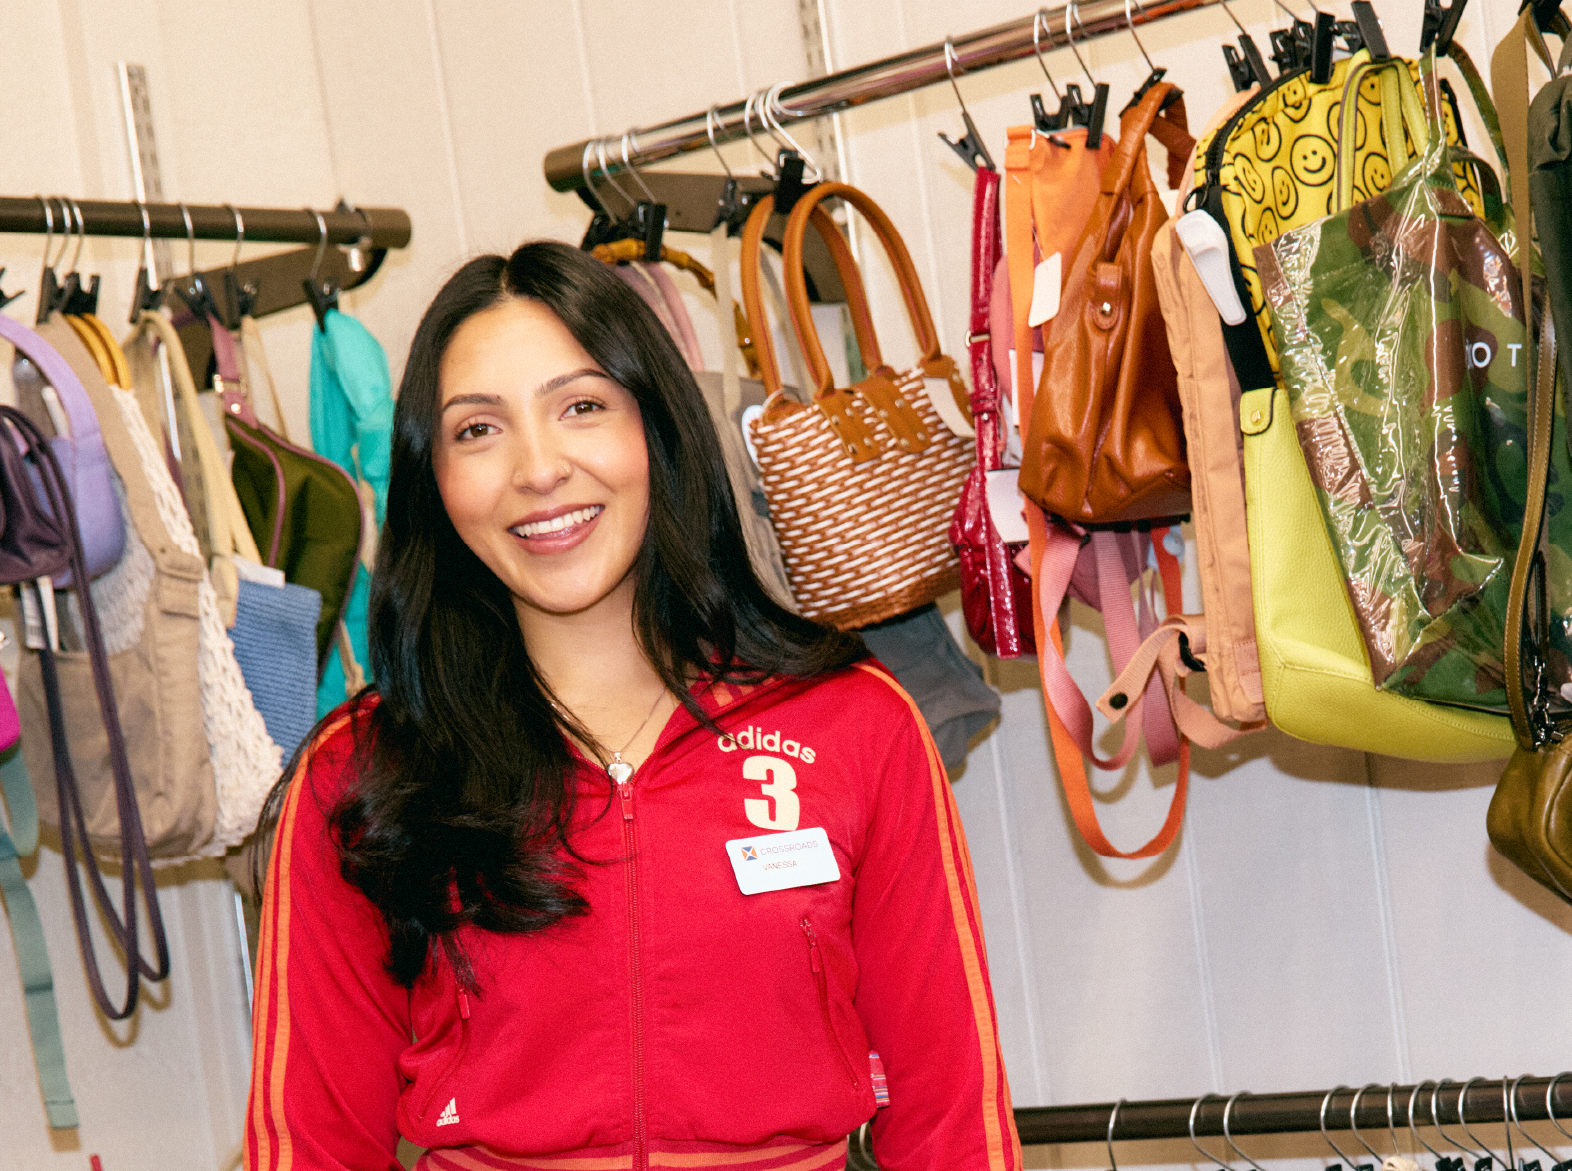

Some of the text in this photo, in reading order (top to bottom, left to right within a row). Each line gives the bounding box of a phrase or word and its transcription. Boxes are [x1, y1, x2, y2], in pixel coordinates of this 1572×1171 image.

[717, 725, 817, 764] adidas
[742, 755, 800, 831] 3
[759, 839, 819, 856] CROSSROADS
[761, 859, 798, 871] VANESSA
[436, 1114, 460, 1127] adidas
